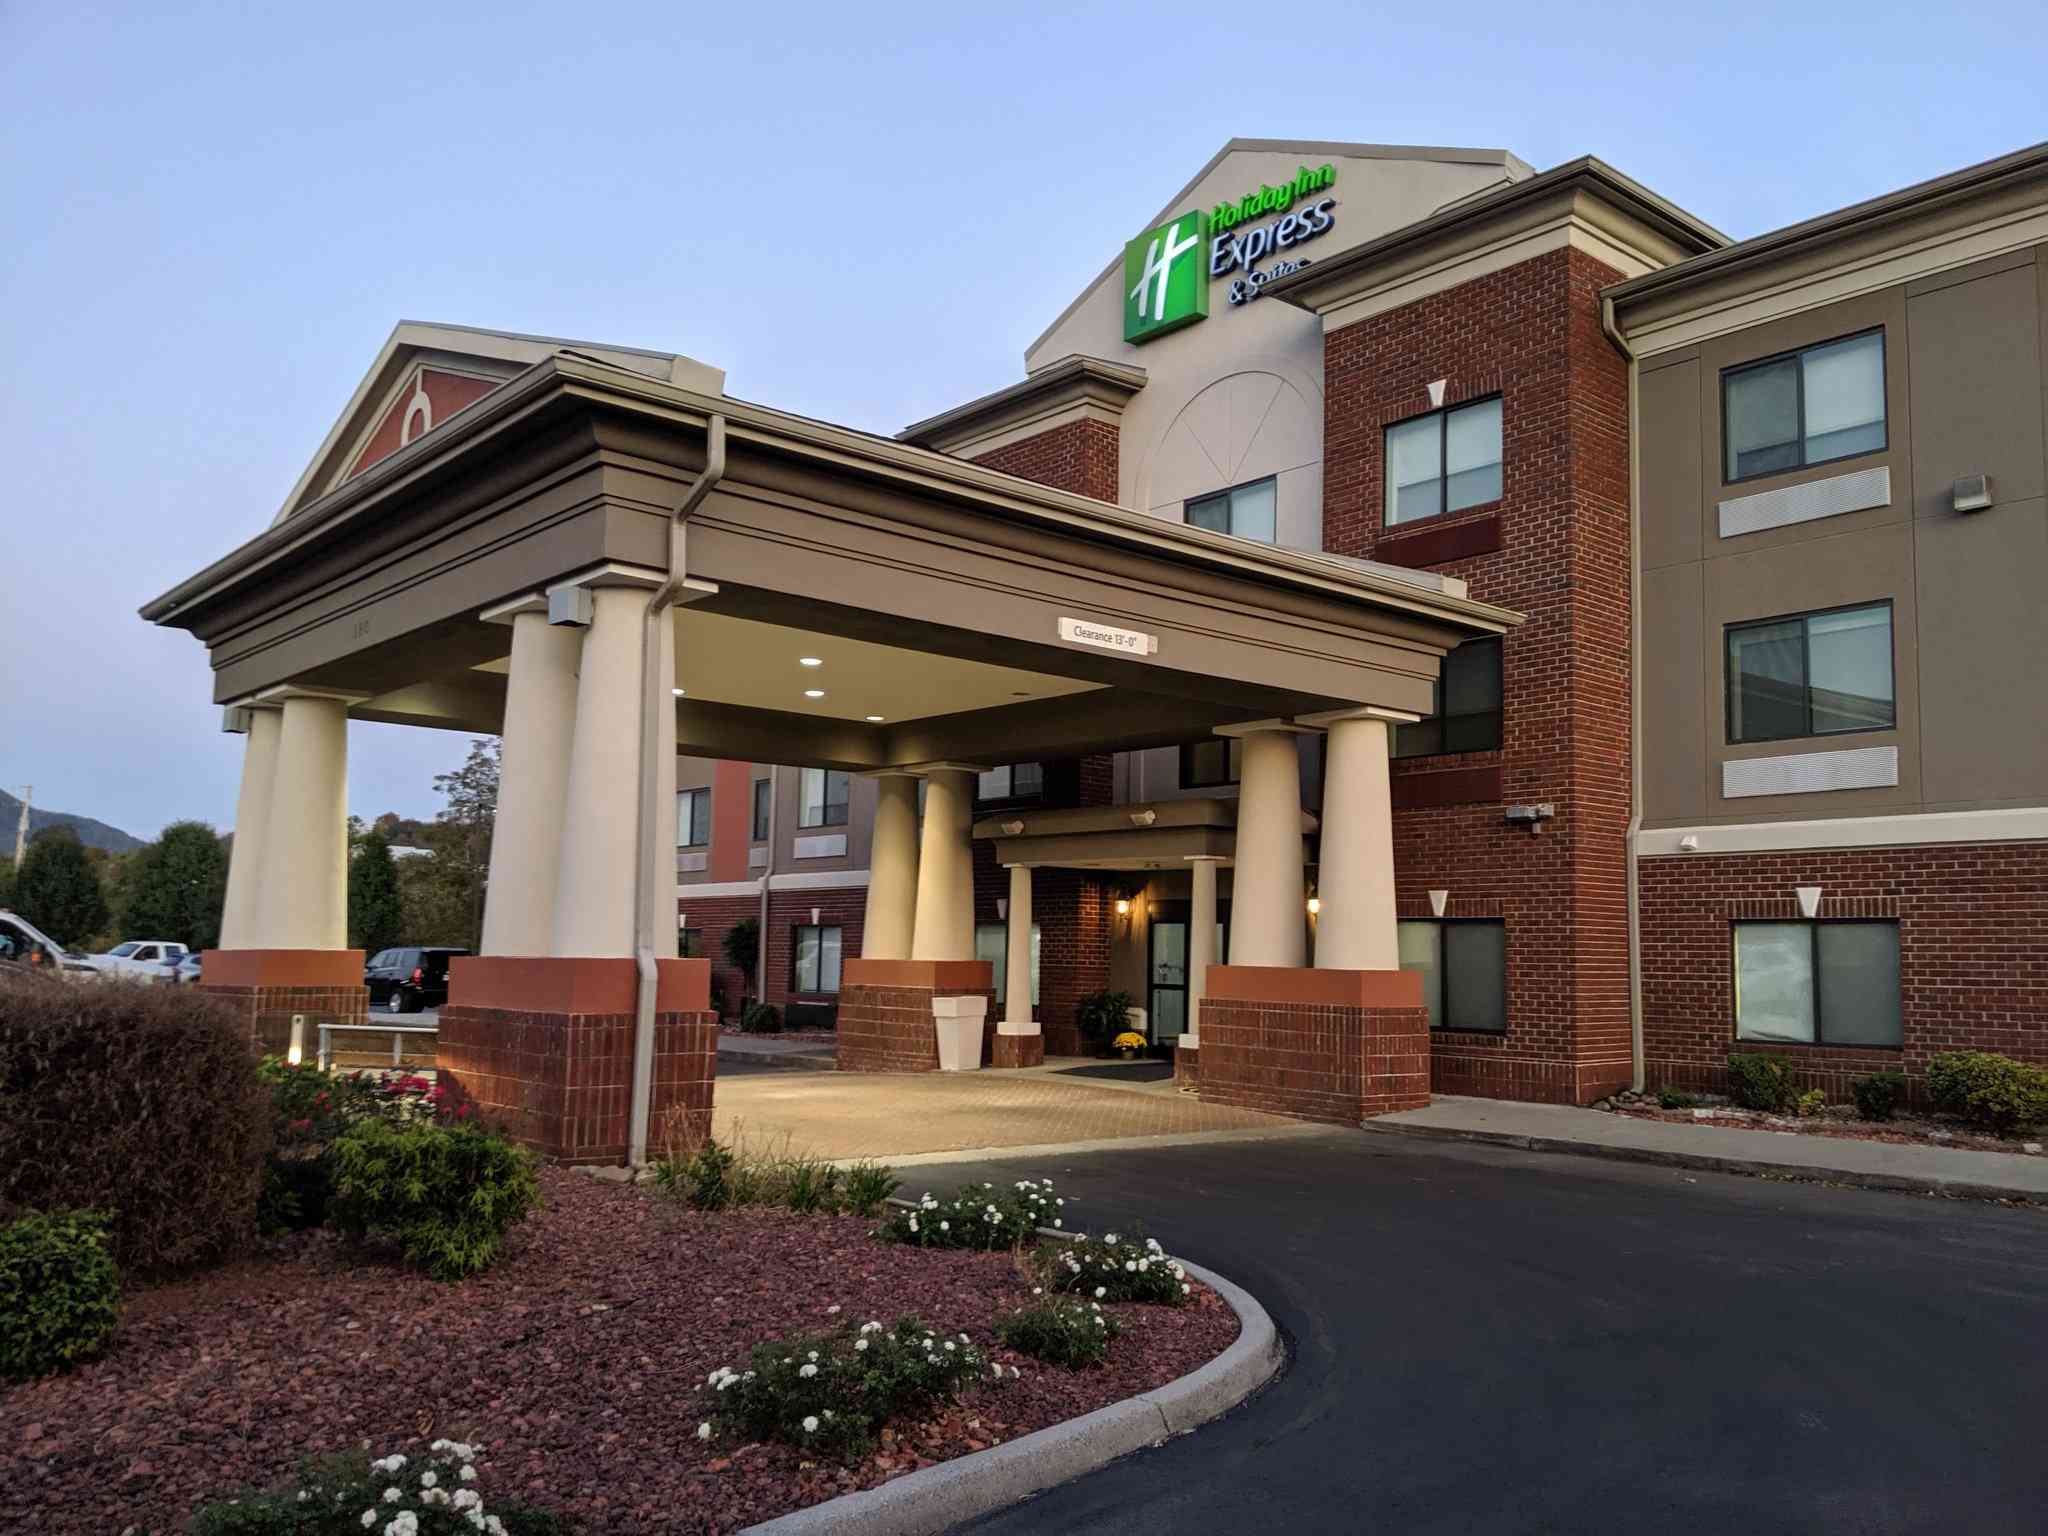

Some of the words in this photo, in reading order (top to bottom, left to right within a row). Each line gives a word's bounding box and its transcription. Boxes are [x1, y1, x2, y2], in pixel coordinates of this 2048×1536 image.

[1209, 180, 1295, 234] Holiday
[1295, 163, 1336, 195] Inn
[1210, 198, 1335, 276] Express
[1228, 280, 1248, 305] &
[1073, 625, 1113, 643] Clearance
